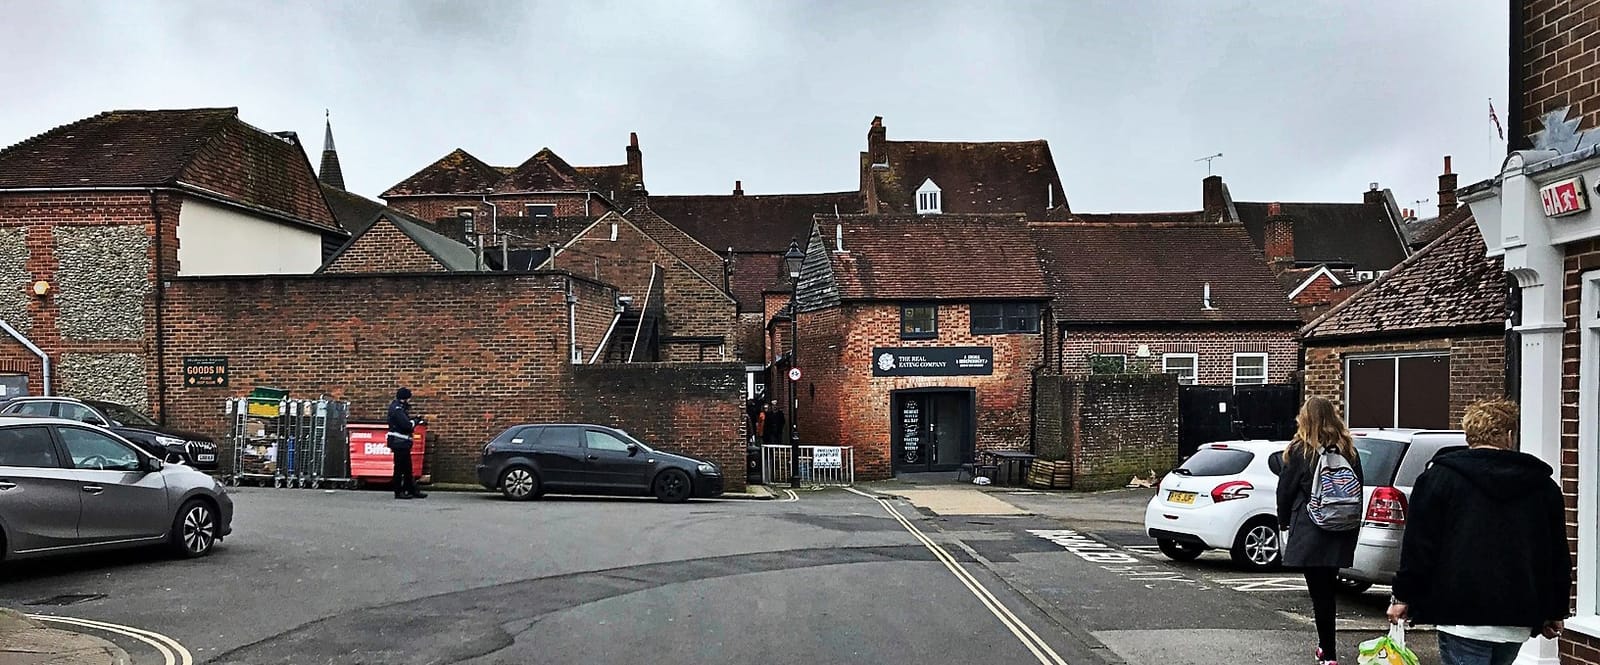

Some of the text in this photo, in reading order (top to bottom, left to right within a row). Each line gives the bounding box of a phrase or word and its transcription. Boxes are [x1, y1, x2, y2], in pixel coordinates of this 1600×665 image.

[1540, 188, 1564, 216] CIA
[187, 365, 225, 375] GOODS IN
